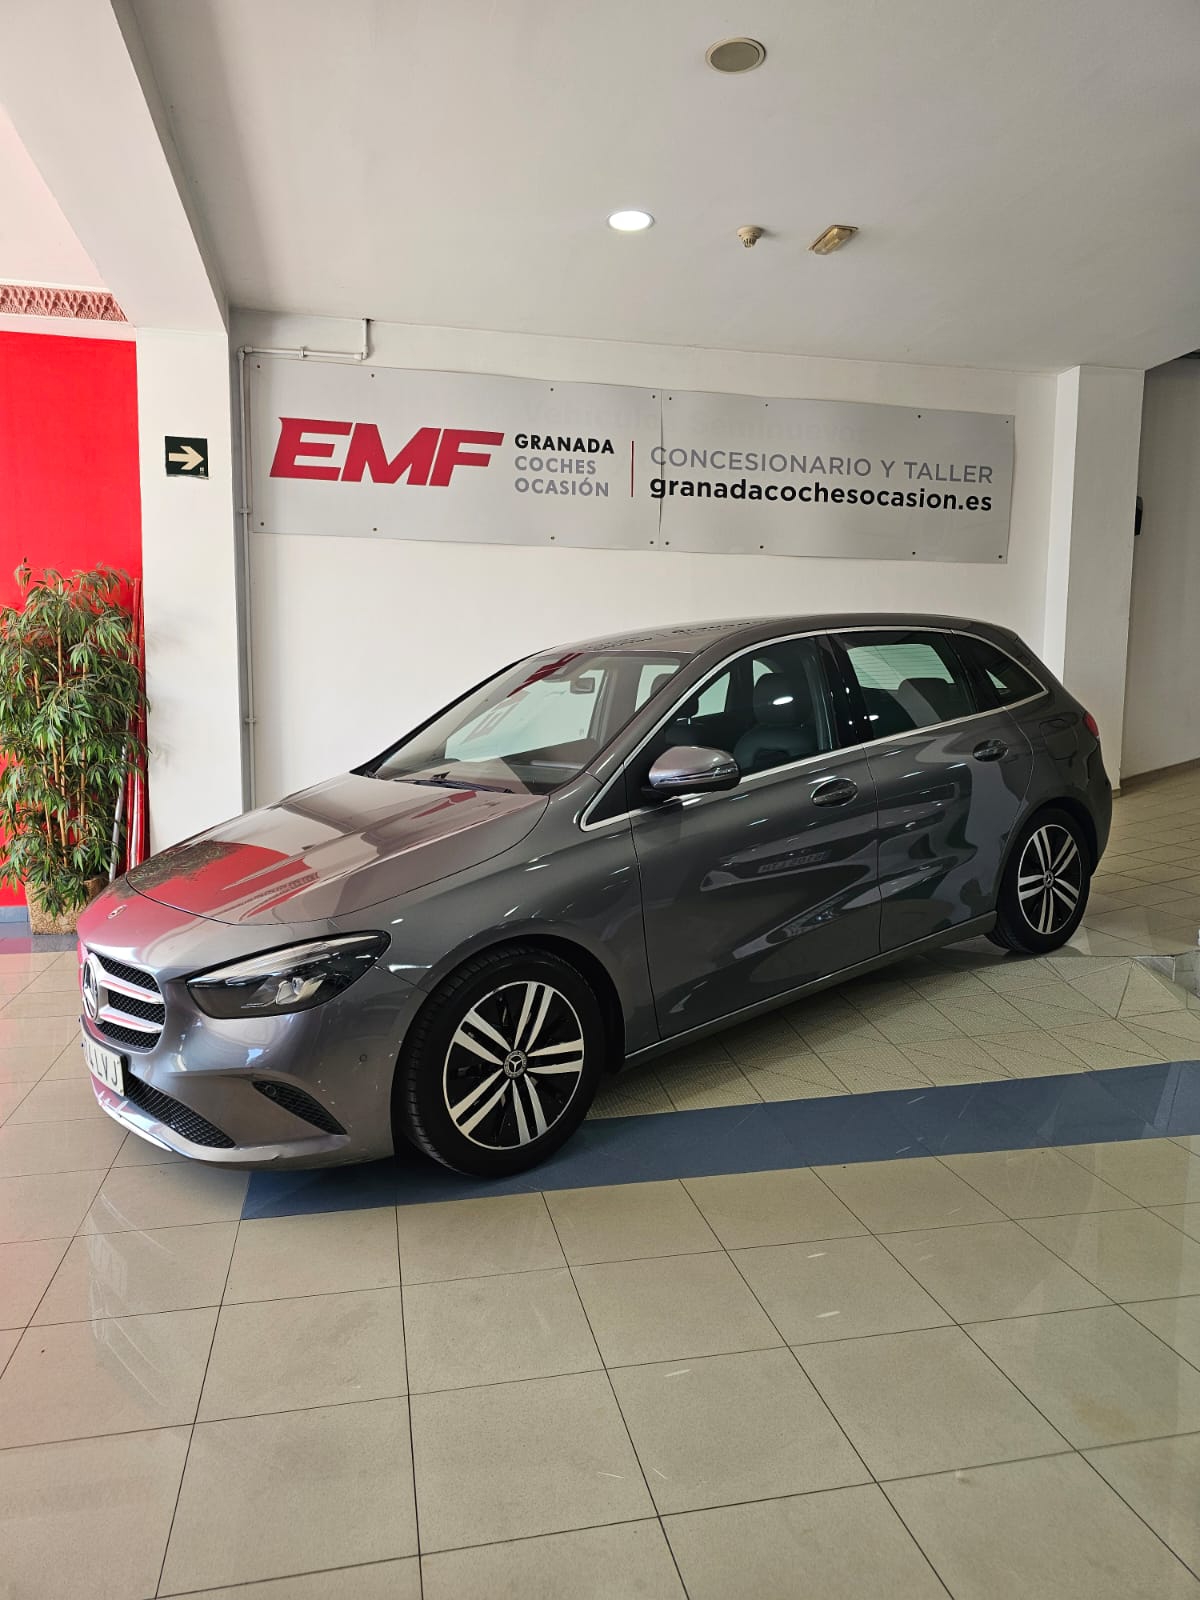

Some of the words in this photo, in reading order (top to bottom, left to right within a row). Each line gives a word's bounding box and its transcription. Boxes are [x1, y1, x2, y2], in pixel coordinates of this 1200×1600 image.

[269, 417, 505, 487] EMF
[514, 433, 615, 455] GRANADA
[514, 455, 597, 475] COCHES
[650, 446, 872, 477] CONCESIONARIO
[880, 459, 896, 479] Y
[904, 461, 993, 484] TALLER
[514, 477, 609, 497] OCASIÓN
[649, 478, 992, 511] granadacochesocasion.es
